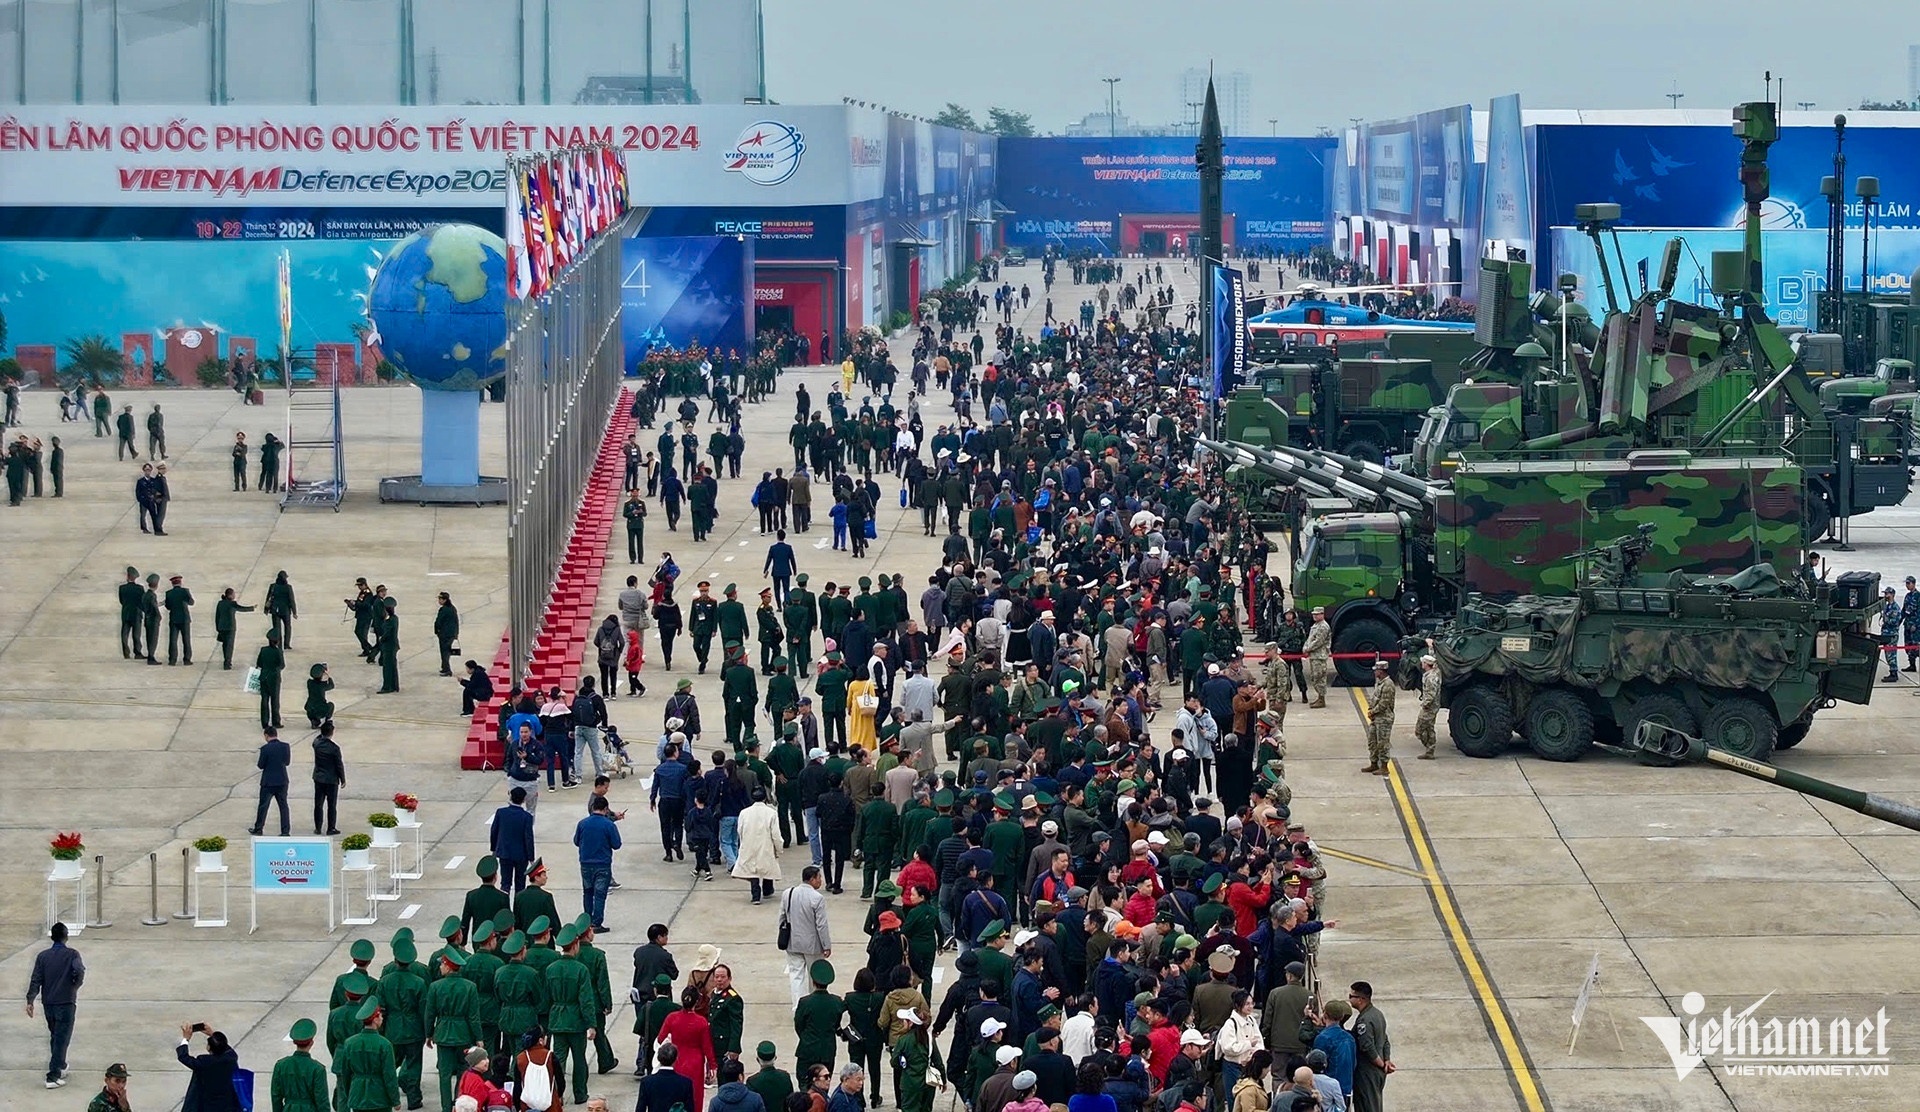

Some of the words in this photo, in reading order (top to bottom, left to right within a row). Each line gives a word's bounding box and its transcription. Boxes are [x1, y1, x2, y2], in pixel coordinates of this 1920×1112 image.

[48, 120, 112, 151] LÃM
[119, 117, 207, 153] QUỐC
[215, 120, 325, 152] PHÒNG
[331, 117, 418, 153] QUỐC
[426, 117, 463, 152] TẾ
[544, 125, 614, 151] NAM
[623, 124, 700, 151] 2024
[1843, 200, 1875, 217] RIỂN
[1879, 202, 1910, 217] LÃM
[197, 221, 214, 239] 19
[223, 221, 242, 239] 22
[268, 222, 276, 230] 12
[279, 222, 315, 238] 2024
[360, 222, 373, 230] GIA
[715, 221, 761, 232] PEACE
[1246, 221, 1291, 232] PEACE
[245, 231, 276, 239] December
[360, 231, 391, 240] Airport,
